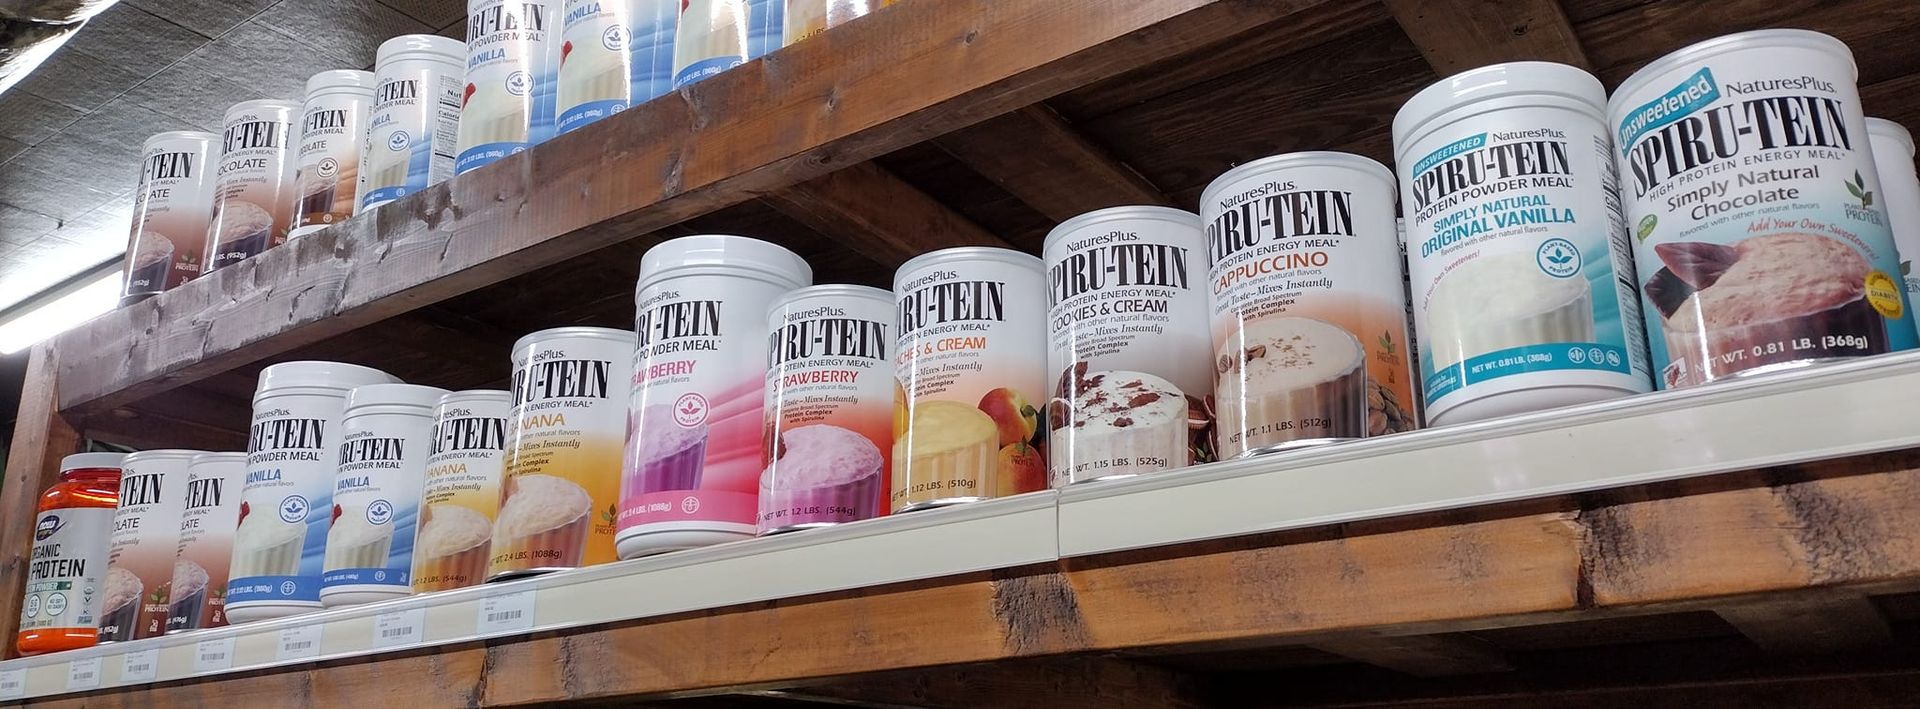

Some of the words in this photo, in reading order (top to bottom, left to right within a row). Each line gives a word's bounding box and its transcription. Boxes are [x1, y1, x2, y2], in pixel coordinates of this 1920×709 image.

[564, 1, 602, 27] VANILLA
[1619, 75, 1713, 150] Unsweetened
[1414, 137, 1482, 174] UNSWEETENED
[1629, 96, 1855, 202] SPIRU-TEIN
[1412, 140, 1573, 215] SPIRU-TEIN
[1649, 182, 1675, 202] HIGH
[1679, 159, 1737, 187] PROTEIN
[1743, 149, 1801, 166] ENERGY
[1667, 179, 1729, 213] Simply
[1737, 164, 1820, 188] Natural
[1415, 195, 1459, 227] PROTEIN
[1462, 179, 1528, 205] POWDER
[1691, 187, 1800, 222] Chocolate
[1433, 205, 1479, 233] SIMPLY
[1482, 194, 1551, 215] NATURAL
[1680, 222, 1710, 239] flavored
[1710, 213, 1731, 228] with
[1731, 207, 1756, 221] other
[1757, 203, 1789, 216] natural
[1791, 200, 1821, 212] flavors
[1845, 208, 1884, 228] PROTEIN
[1206, 190, 1356, 271] PIRU-TEIN
[1421, 216, 1494, 260] ORIGINAL
[1493, 208, 1577, 230] VANILLA
[1746, 217, 1771, 234] Add
[1773, 216, 1798, 230] Your
[1800, 217, 1826, 232] Own
[1464, 236, 1478, 247] with
[1479, 232, 1497, 243] other
[1498, 228, 1528, 240] natural
[1529, 225, 1549, 236] flavors
[1219, 250, 1255, 273] PROTEIN
[1256, 241, 1303, 257] ENERGY
[1047, 244, 1190, 312] SPIRU-TEIN
[1213, 251, 1330, 296] CAPPUCCINO
[1249, 275, 1268, 288] other
[1268, 269, 1296, 284] natural
[1297, 268, 1323, 280] flavors
[1286, 276, 1334, 295] Instantly
[1064, 293, 1098, 311] PROTEIN
[1101, 289, 1143, 300] ENERGY
[1260, 297, 1296, 310] Complex
[1272, 290, 1303, 303] Spectrum
[896, 281, 1007, 342] IRU-TEIN
[1053, 303, 1097, 334] COOKIES
[1100, 301, 1110, 316] &
[1114, 300, 1168, 313] CREAM
[1086, 316, 1107, 328] other
[1110, 313, 1140, 324] natural
[1142, 312, 1169, 323] flavors
[1257, 307, 1287, 319] Spirulina
[922, 324, 959, 338] ENERGY
[1121, 324, 1164, 335] Instantly
[767, 319, 887, 371] PIRU-TEIN
[897, 344, 921, 367] ACHES
[923, 341, 934, 356] &
[936, 336, 987, 352] CREAM
[1093, 348, 1121, 357] Spirulina
[1097, 341, 1129, 351] Complex
[1721, 349, 1748, 367] WT.
[1752, 341, 1785, 358] 0.81
[1791, 337, 1817, 351] LB.
[1820, 334, 1870, 351] (368g)
[808, 359, 844, 368] ENERGY
[958, 350, 981, 361] flavors
[942, 361, 983, 373] Instantly
[1472, 364, 1485, 374] NET
[1485, 361, 1498, 370] WT.
[838, 383, 858, 391] flavors
[927, 379, 955, 390] Complex
[530, 401, 562, 412] ENERGY
[824, 395, 859, 405] Instantly
[784, 410, 804, 420] Protein
[805, 409, 833, 417] Complex
[558, 428, 581, 436] flavors
[1261, 423, 1272, 435] 1.1
[1275, 419, 1295, 432] LBS.
[1299, 417, 1331, 431] (512g)
[542, 438, 581, 449] Instantly
[253, 451, 287, 463] POWDER
[522, 459, 550, 468] Complex
[1076, 462, 1091, 474] WT.
[1093, 459, 1109, 470] 1.15
[1112, 458, 1132, 468] LBS.
[1136, 456, 1168, 468] (525g)
[246, 468, 281, 484] VANILLA
[345, 462, 373, 472] POWDER
[337, 477, 370, 490] VANILLA
[947, 479, 977, 489] (510g)
[763, 511, 775, 521] NET
[826, 506, 857, 517] (544g)
[531, 548, 562, 560] (1088g)
[31, 558, 86, 580] PROTEIN
